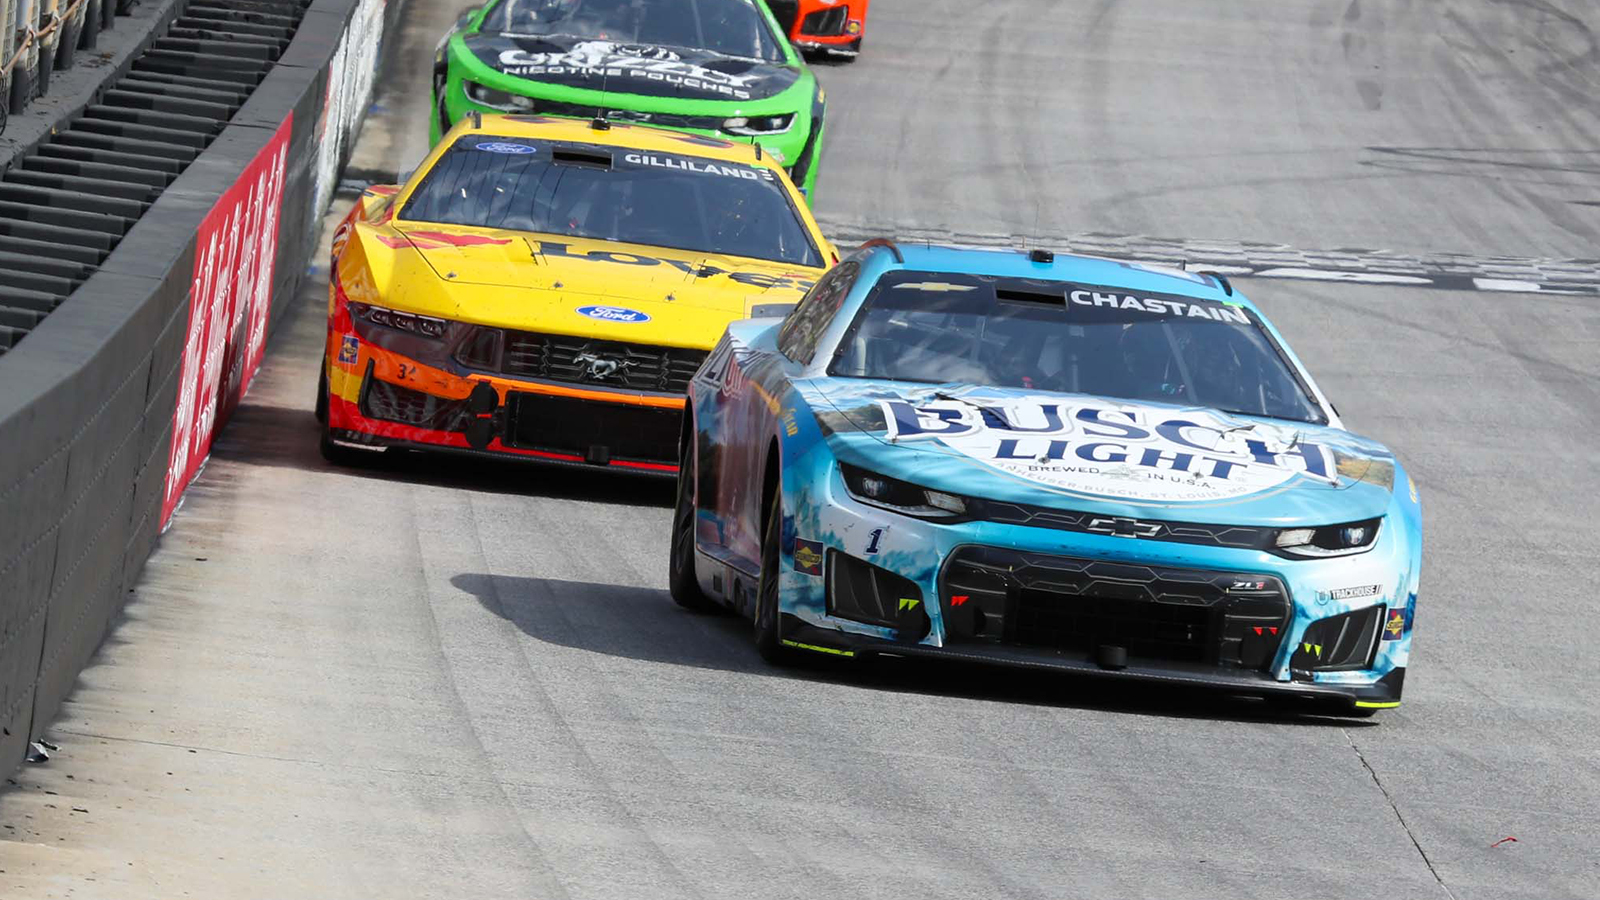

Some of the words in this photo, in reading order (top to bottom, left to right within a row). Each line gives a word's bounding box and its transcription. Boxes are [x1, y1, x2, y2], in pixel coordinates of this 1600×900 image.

[503, 66, 622, 77] NICOTINE
[630, 69, 751, 99] POUCHES
[625, 153, 758, 180] GILLILAND
[586, 306, 641, 321] Ford
[1070, 290, 1250, 325] CHASTAIN
[397, 364, 417, 382] 3
[889, 401, 1327, 478] BUSCH
[994, 439, 1248, 480] LIGHT
[1028, 465, 1100, 474] BREWED
[1147, 473, 1165, 481] IN
[865, 528, 883, 554] 1
